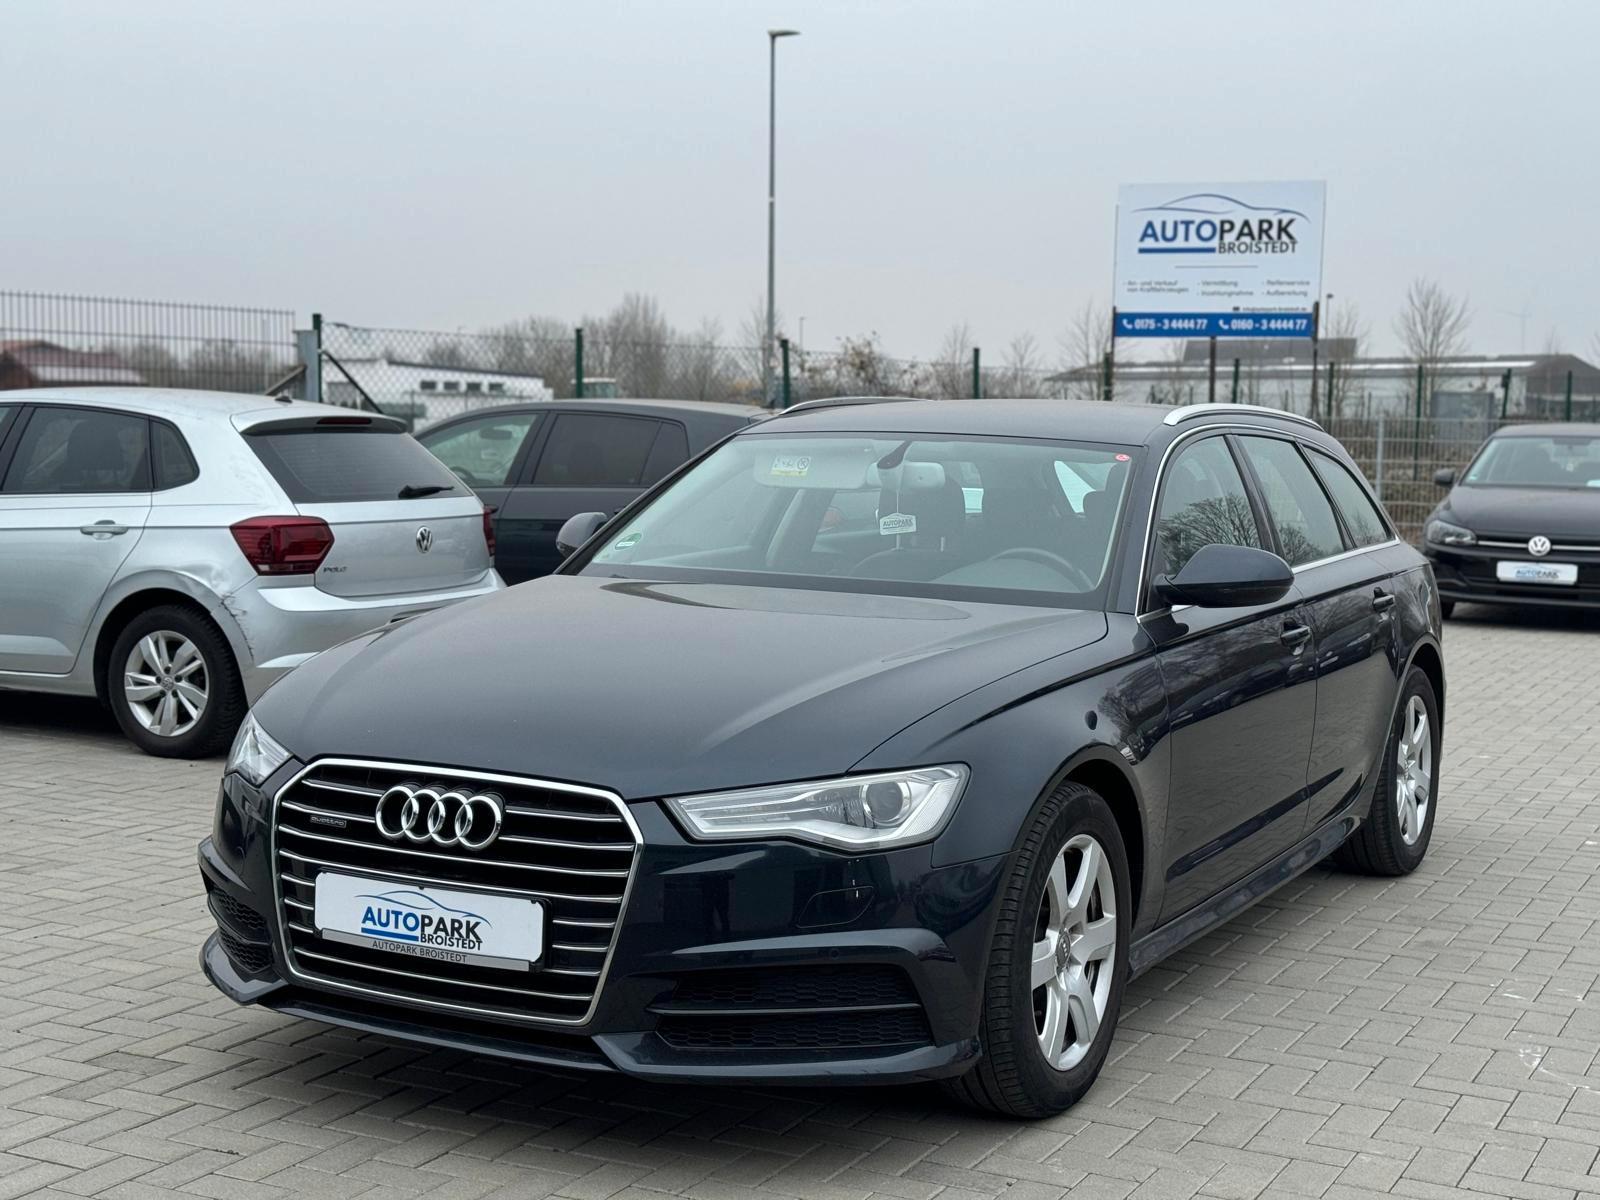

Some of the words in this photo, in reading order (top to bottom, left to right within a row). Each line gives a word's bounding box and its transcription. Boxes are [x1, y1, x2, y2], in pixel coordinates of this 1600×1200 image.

[1138, 218, 1297, 242] AUTOPARK
[1218, 240, 1298, 254] BROISTEDT
[1202, 280, 1238, 288] Vermittlung
[1134, 318, 1156, 330] 0175
[882, 518, 913, 528] AUTOPARK
[1515, 569, 1559, 578] AUTOPARK
[361, 906, 481, 941] AUTOPARK
[420, 933, 483, 951] BROISTEDT
[372, 940, 418, 955] AUTOPARK
[419, 948, 467, 963] BROISTEDT
